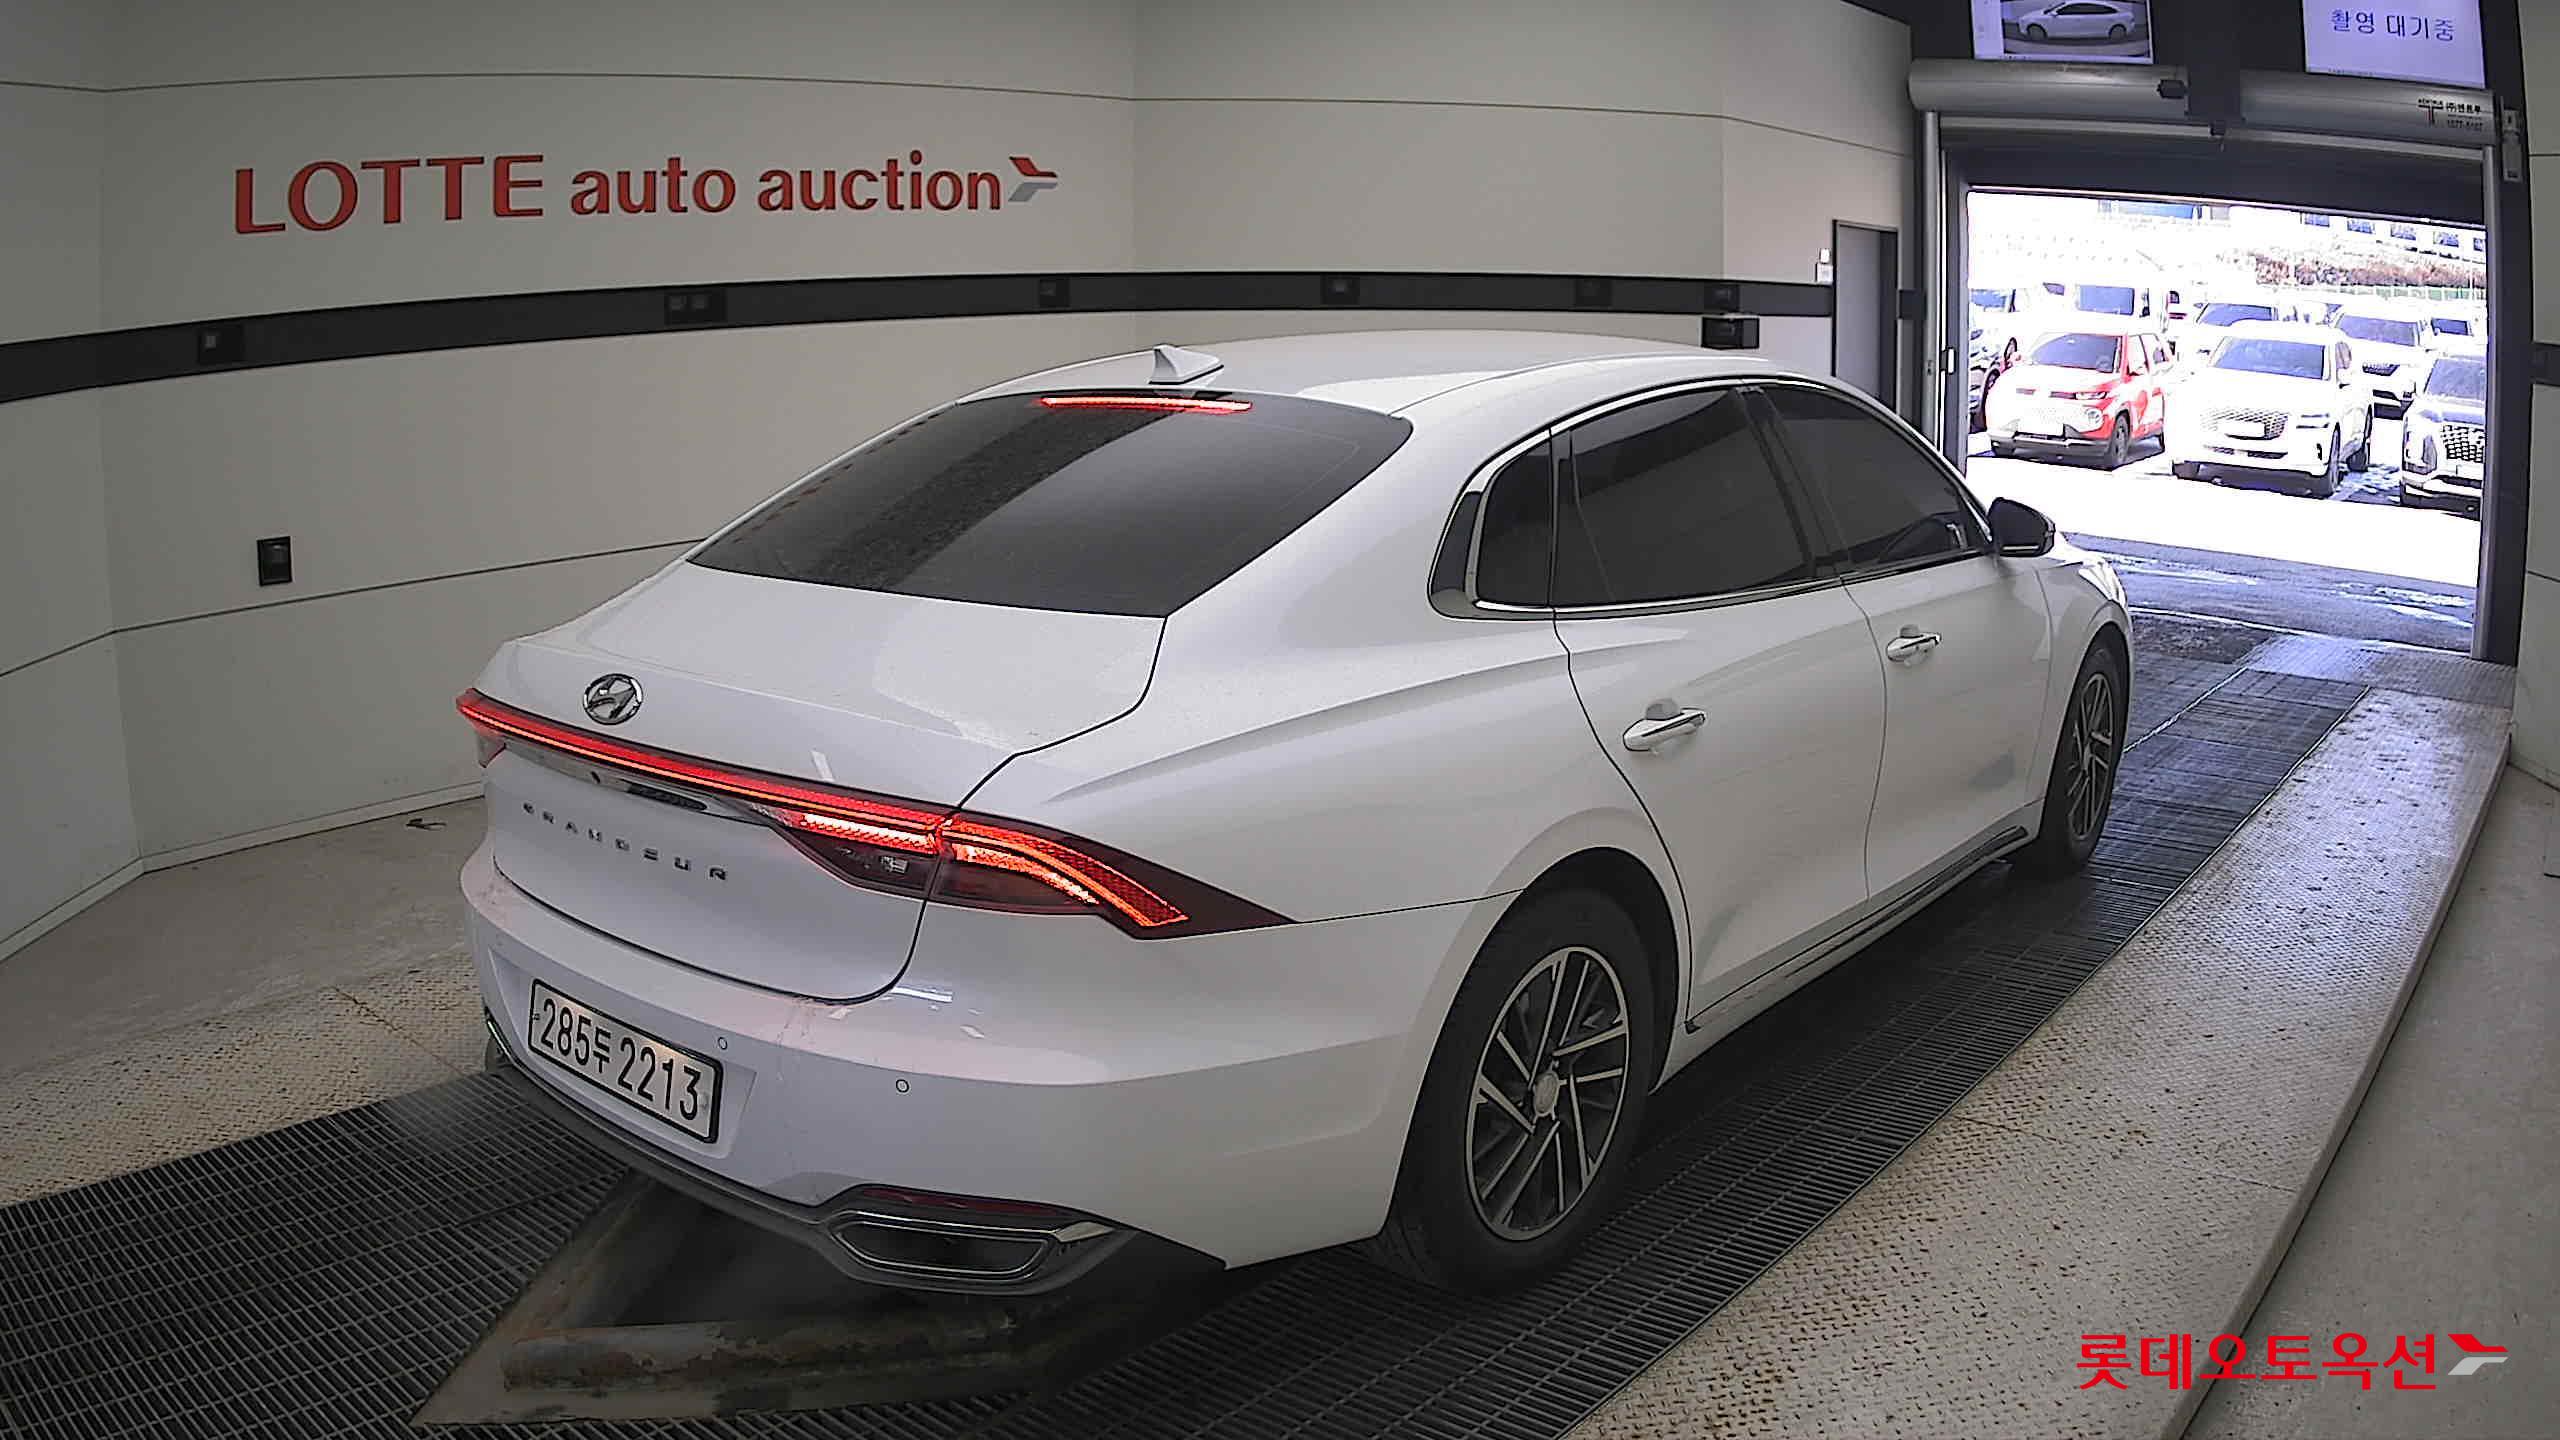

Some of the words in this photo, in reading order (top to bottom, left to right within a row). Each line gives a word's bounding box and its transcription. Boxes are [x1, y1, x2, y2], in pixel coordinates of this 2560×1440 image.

[2331, 9, 2375, 34] 촬영
[2386, 15, 2455, 41] 대기중
[233, 154, 544, 234] LOTTE
[571, 158, 736, 217] auto
[760, 150, 1001, 213] auction
[541, 998, 611, 1073] 285두
[617, 1038, 702, 1120] 2213
